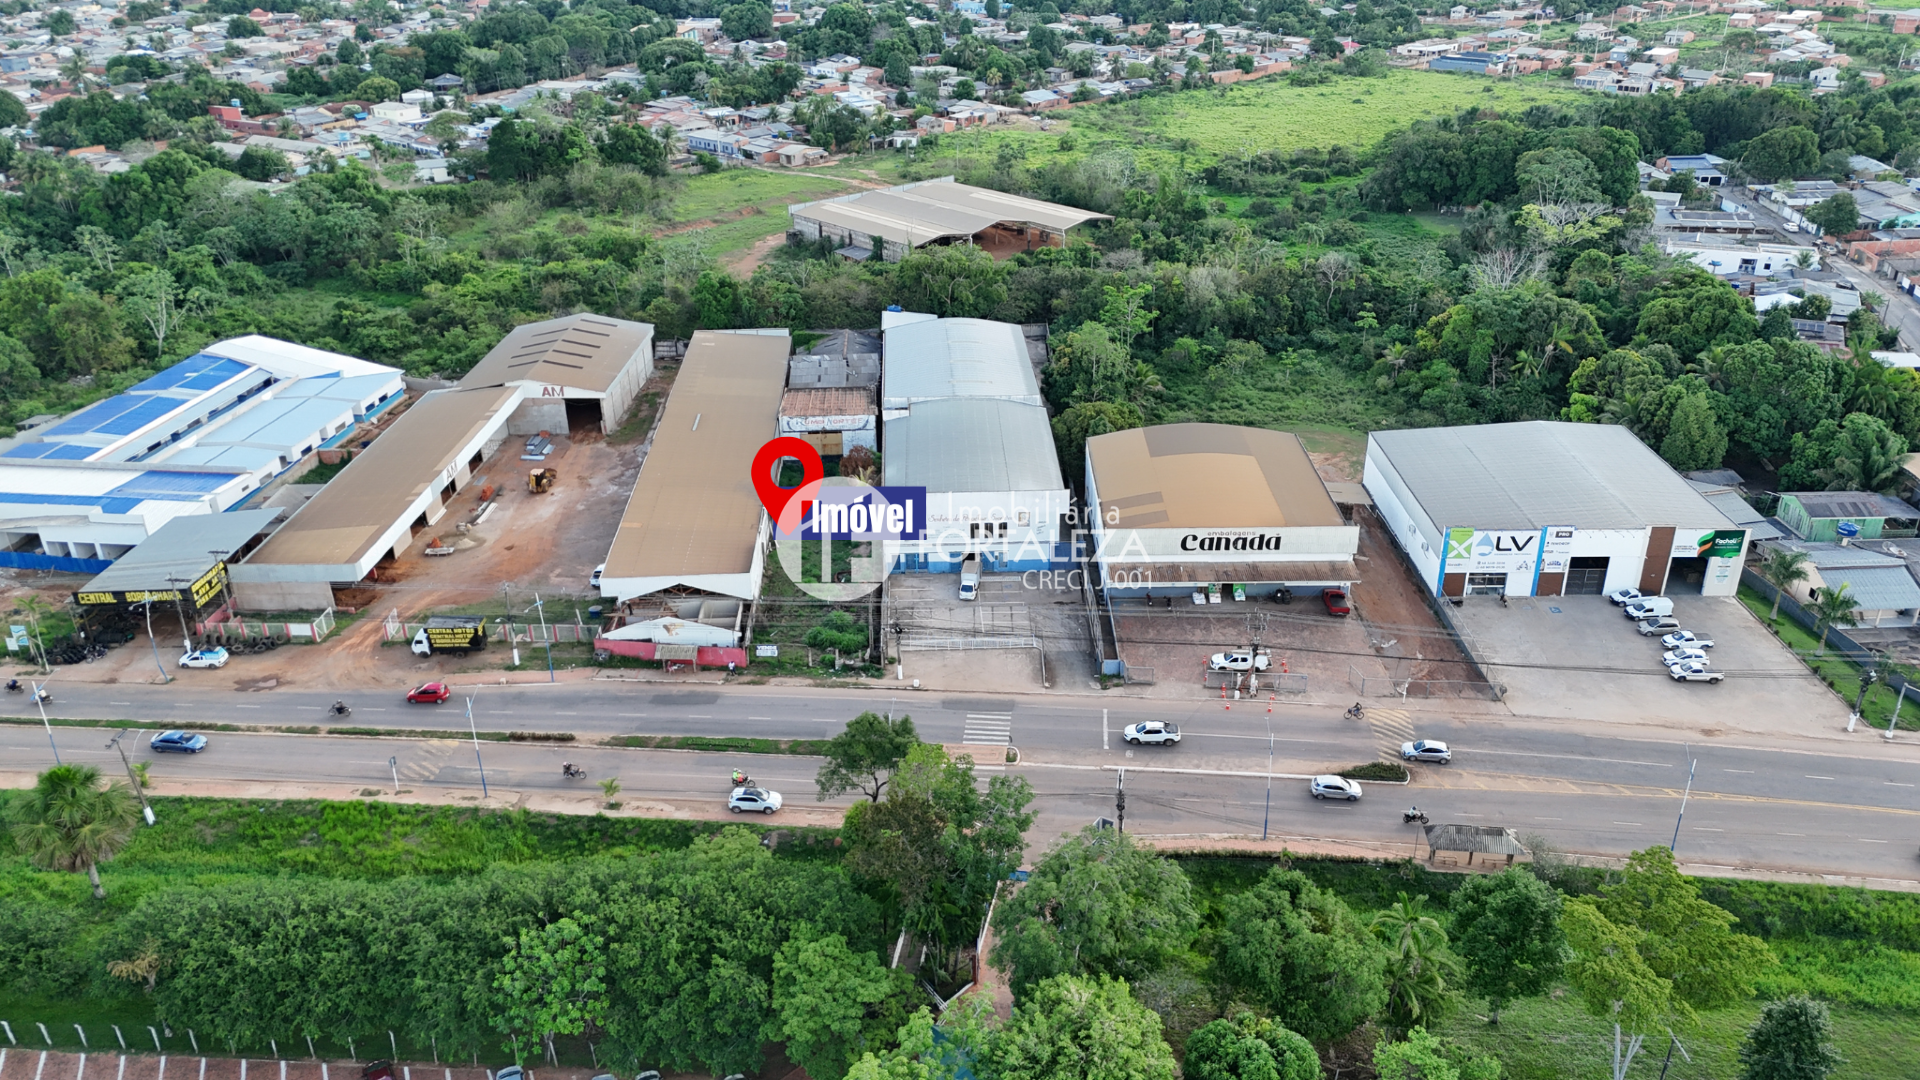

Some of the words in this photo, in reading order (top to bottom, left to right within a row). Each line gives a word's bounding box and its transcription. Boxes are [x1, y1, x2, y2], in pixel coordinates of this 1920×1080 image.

[542, 386, 565, 397] AM
[446, 460, 458, 479] AM
[1495, 535, 1535, 552] LV
[78, 592, 117, 604] CENTRAL
